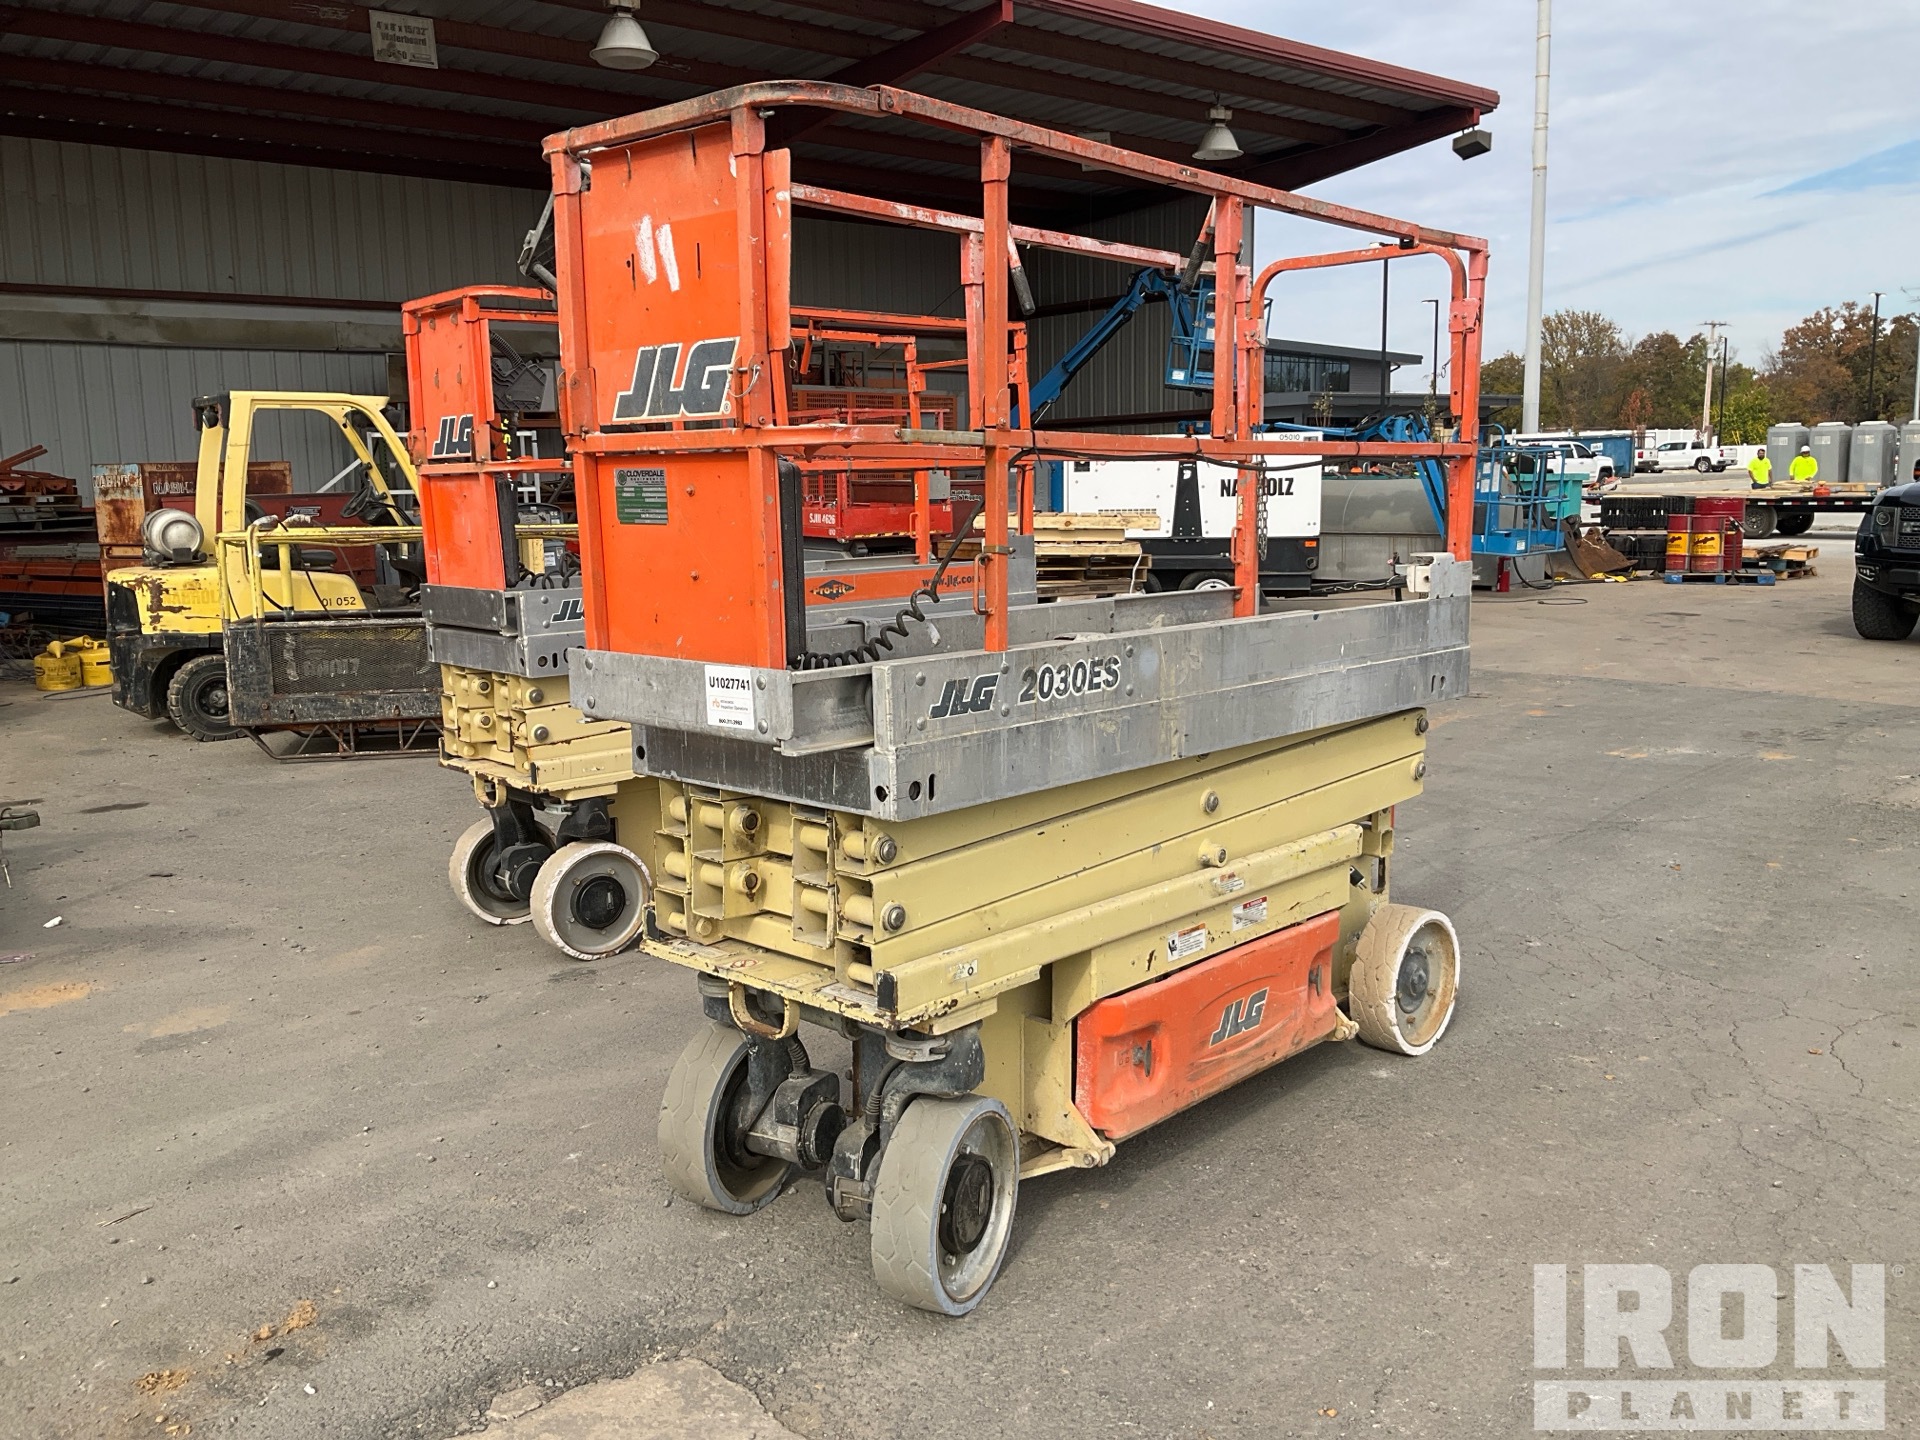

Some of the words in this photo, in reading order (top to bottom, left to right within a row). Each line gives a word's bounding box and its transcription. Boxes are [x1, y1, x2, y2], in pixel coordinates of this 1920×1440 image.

[612, 336, 740, 421] JLG
[432, 414, 474, 456] JLG
[1279, 433, 1300, 441] 05010
[626, 470, 665, 478] CLOVERDALE
[1220, 477, 1294, 497] NAOLZ
[336, 596, 357, 606] 052
[550, 598, 585, 623] JL
[709, 676, 750, 690] U1027741
[928, 673, 1000, 720] JLG
[1017, 655, 1121, 706] 2030ES
[1210, 987, 1269, 1047] JLG
